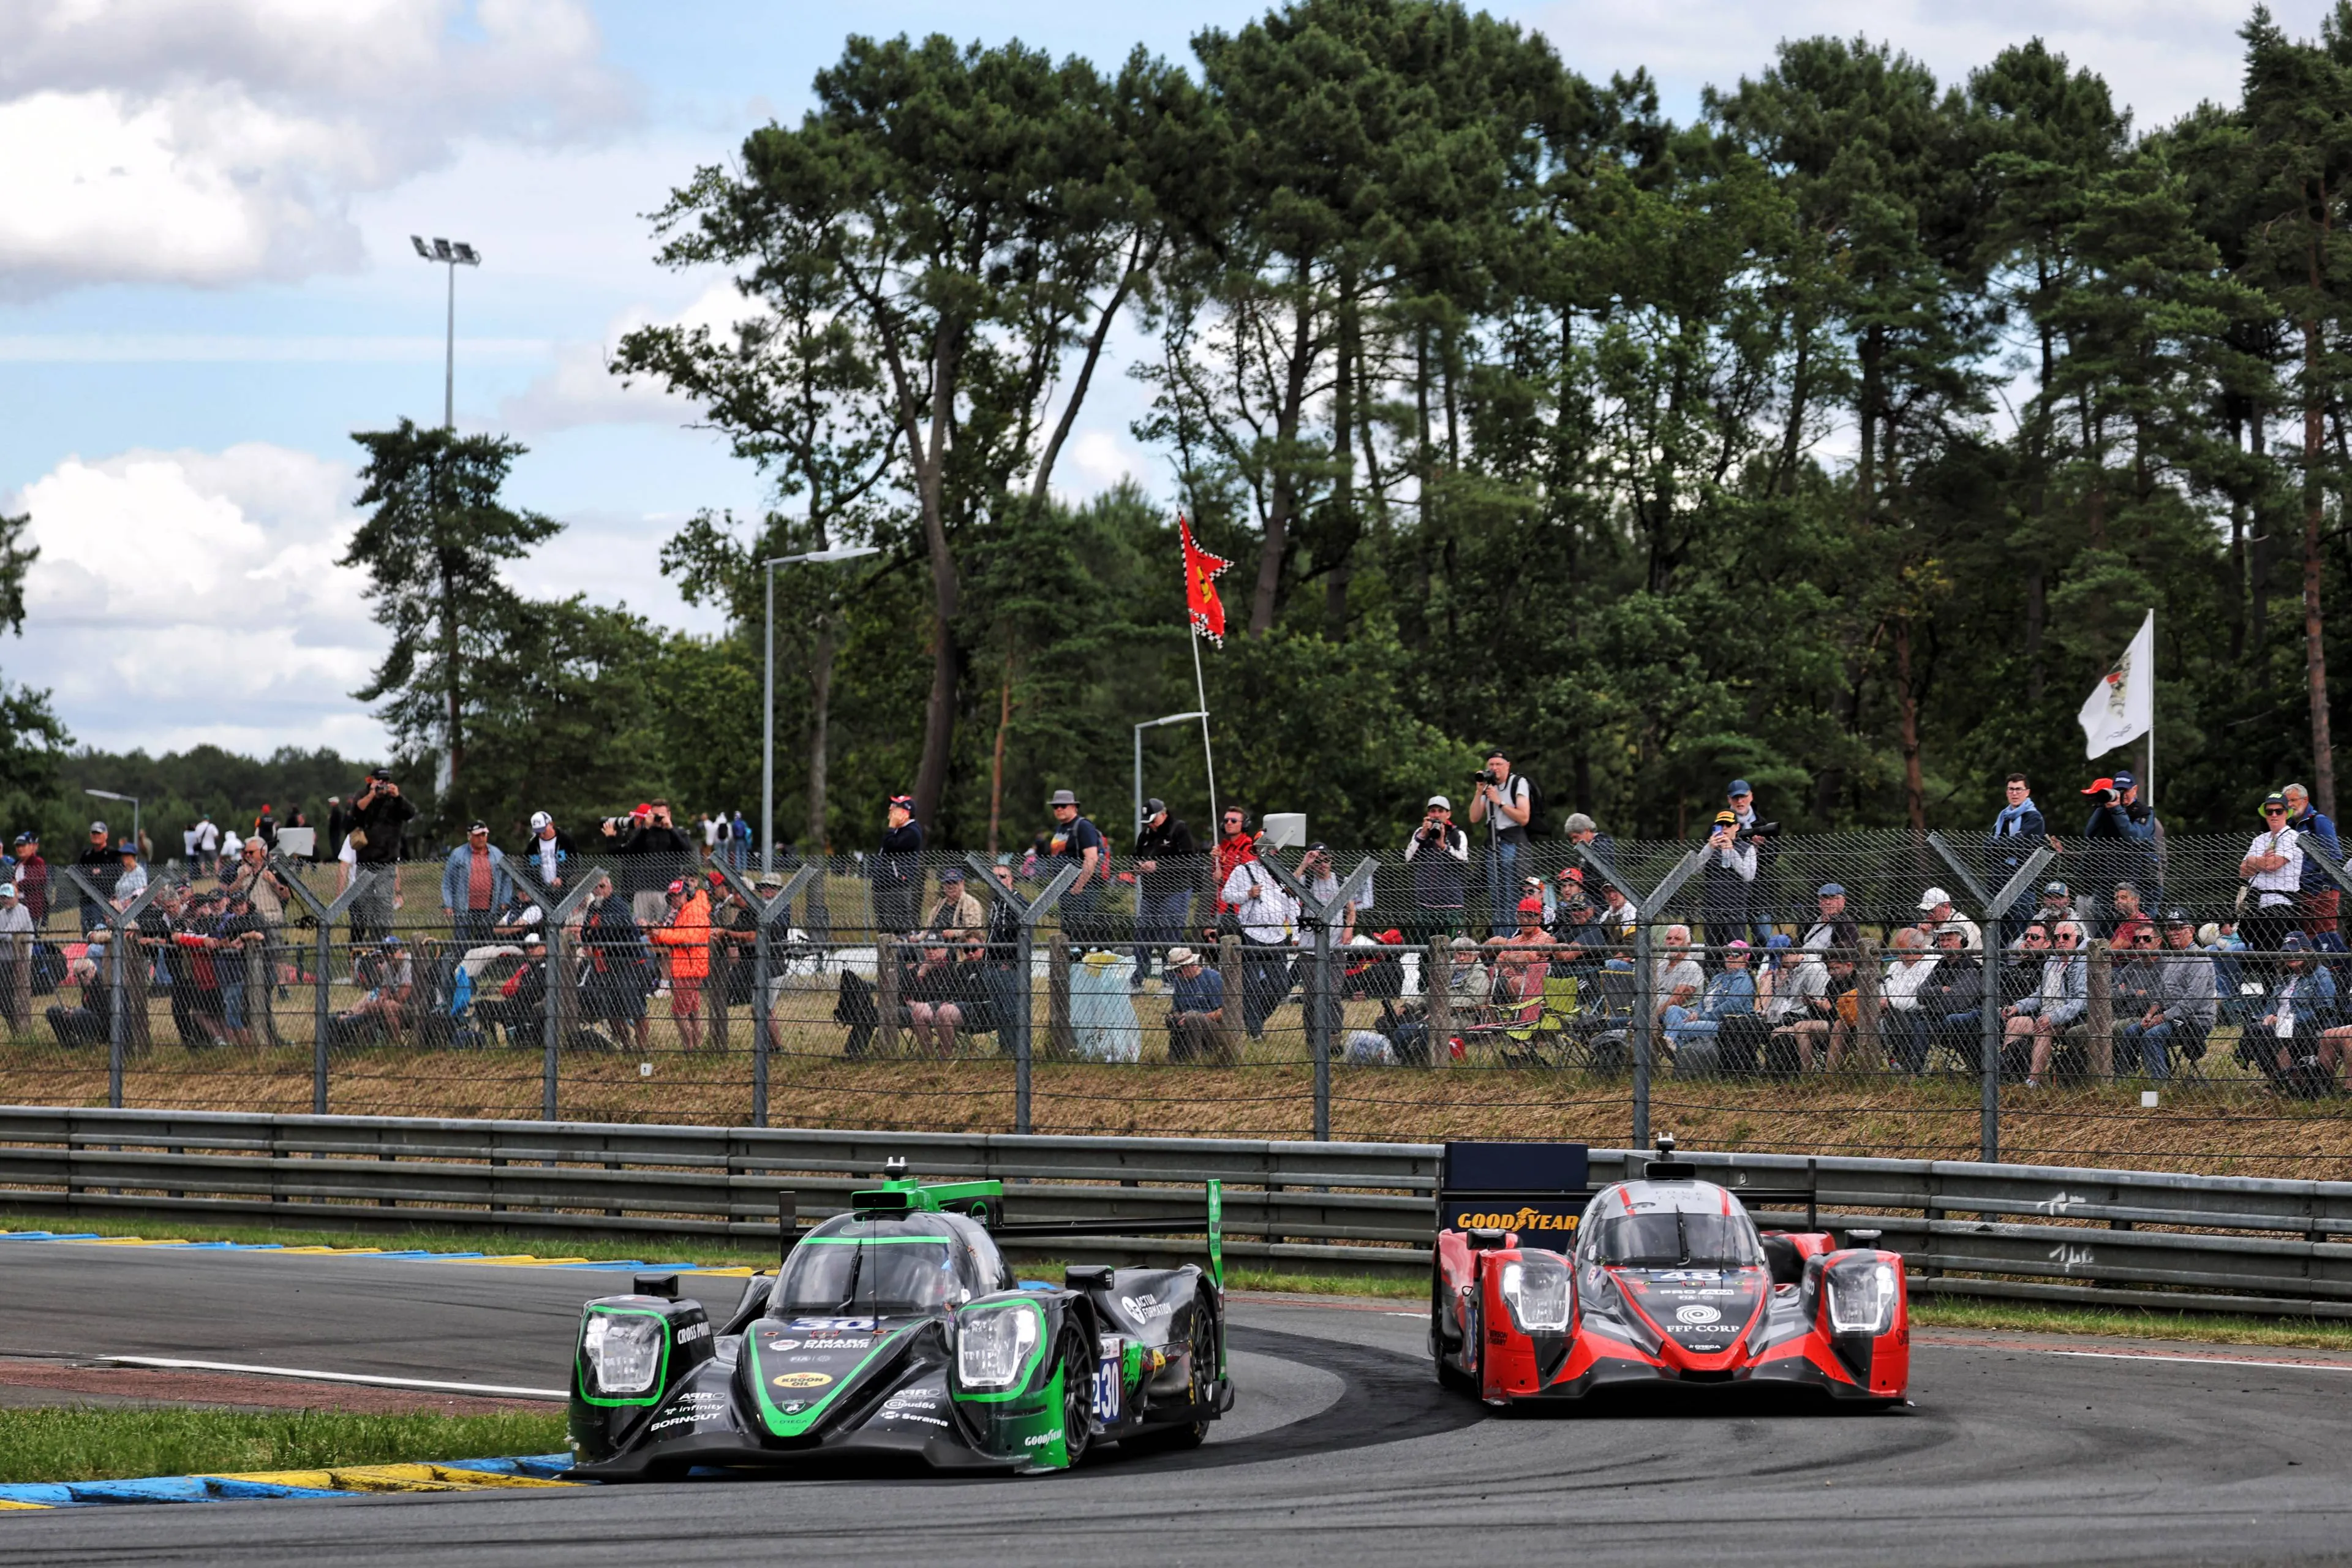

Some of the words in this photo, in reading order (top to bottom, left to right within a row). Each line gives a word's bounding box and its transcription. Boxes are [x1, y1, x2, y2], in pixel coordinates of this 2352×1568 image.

[1660, 1272, 1722, 1281] 48
[1135, 1294, 1157, 1309] ACTUA
[1142, 1302, 1172, 1319] FORMATION
[791, 1320, 875, 1330] 30
[677, 1324, 696, 1344] CROSS
[1101, 1362, 1120, 1419] 30
[679, 1404, 725, 1412] infinity
[902, 1413, 949, 1427] Sorama
